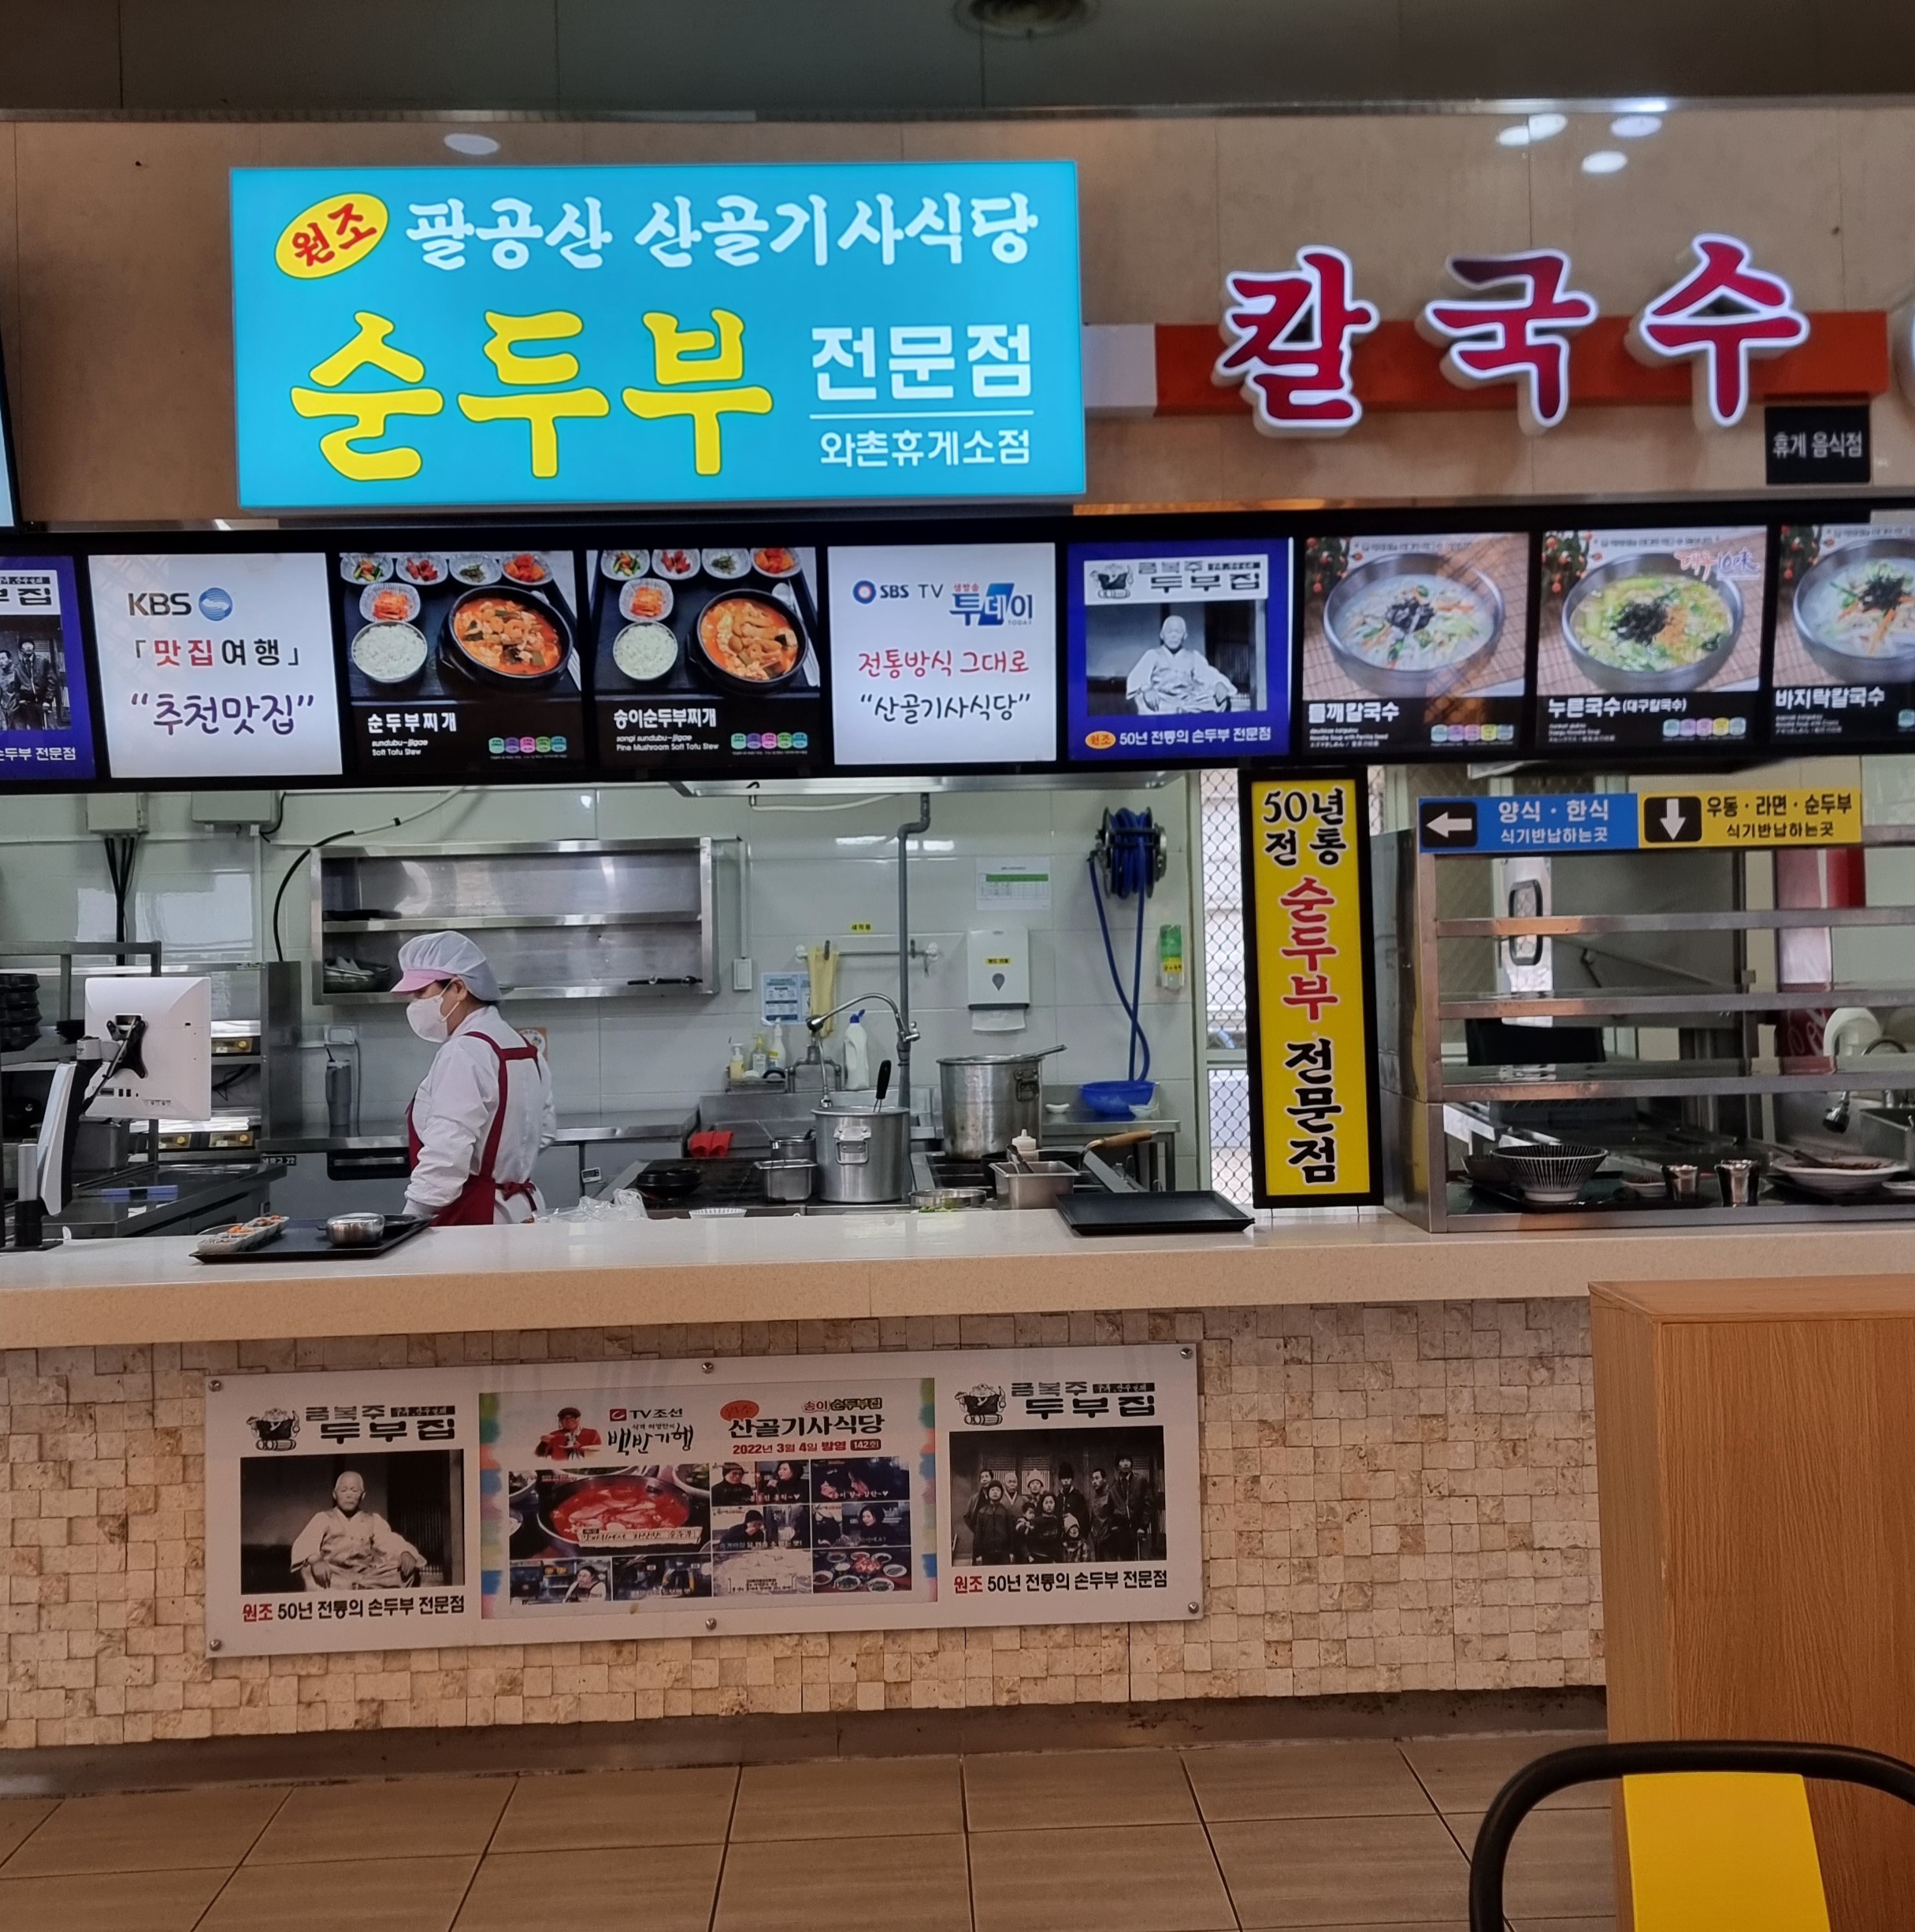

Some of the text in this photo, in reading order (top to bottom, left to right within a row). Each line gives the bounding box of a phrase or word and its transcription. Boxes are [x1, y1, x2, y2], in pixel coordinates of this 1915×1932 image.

[291, 191, 1037, 271] 원조 팔공산 산골기사식당
[1214, 233, 1810, 429] 칼국수
[810, 324, 1032, 401] 전문점
[291, 309, 774, 481] 순두부
[820, 431, 1030, 469] 와촌휴게소점
[1773, 430, 1863, 458] 휴게 음식점
[880, 584, 944, 599] SBS TV
[1151, 573, 1260, 593] 두부집
[128, 592, 192, 616] KBS
[949, 592, 1033, 626] 투데이
[859, 650, 1029, 679] 전통방식 그대로
[1549, 697, 1620, 718] 누른국수
[1776, 686, 1885, 710] 바지락칼국수
[368, 712, 457, 733] 순두부찌개
[614, 708, 717, 729] 송이순두부찌개
[1119, 732, 1148, 746] 50년
[1151, 730, 1188, 744] 전통의
[1192, 729, 1230, 744] 손두부
[1234, 726, 1271, 741] 전문점
[35, 747, 76, 761] 전문점
[1263, 788, 1344, 825] 50년
[1497, 799, 1609, 823] 양식 한식
[1707, 795, 1852, 818] 우동 라면 순두부
[1501, 827, 1608, 844] 식기반납하는곳
[1727, 822, 1834, 839] 식기반납하는곳
[1264, 828, 1346, 866] 전통
[1280, 877, 1338, 1020] 순두부
[1285, 1038, 1342, 1184] 전문점
[803, 1398, 882, 1411] 송이 순두부집
[1026, 1396, 1155, 1420] 두부집
[321, 1418, 455, 1444] 두부집
[729, 1415, 885, 1438] 산골기사식당
[608, 1423, 693, 1456] 백반기행
[733, 1441, 880, 1455] 2022년 3월 4일 방영 142회
[953, 1570, 1167, 1594] 원조 50년 전통의 손두부 전문점
[242, 1595, 464, 1622] 원조 50년 전통의 손두부 전문점
